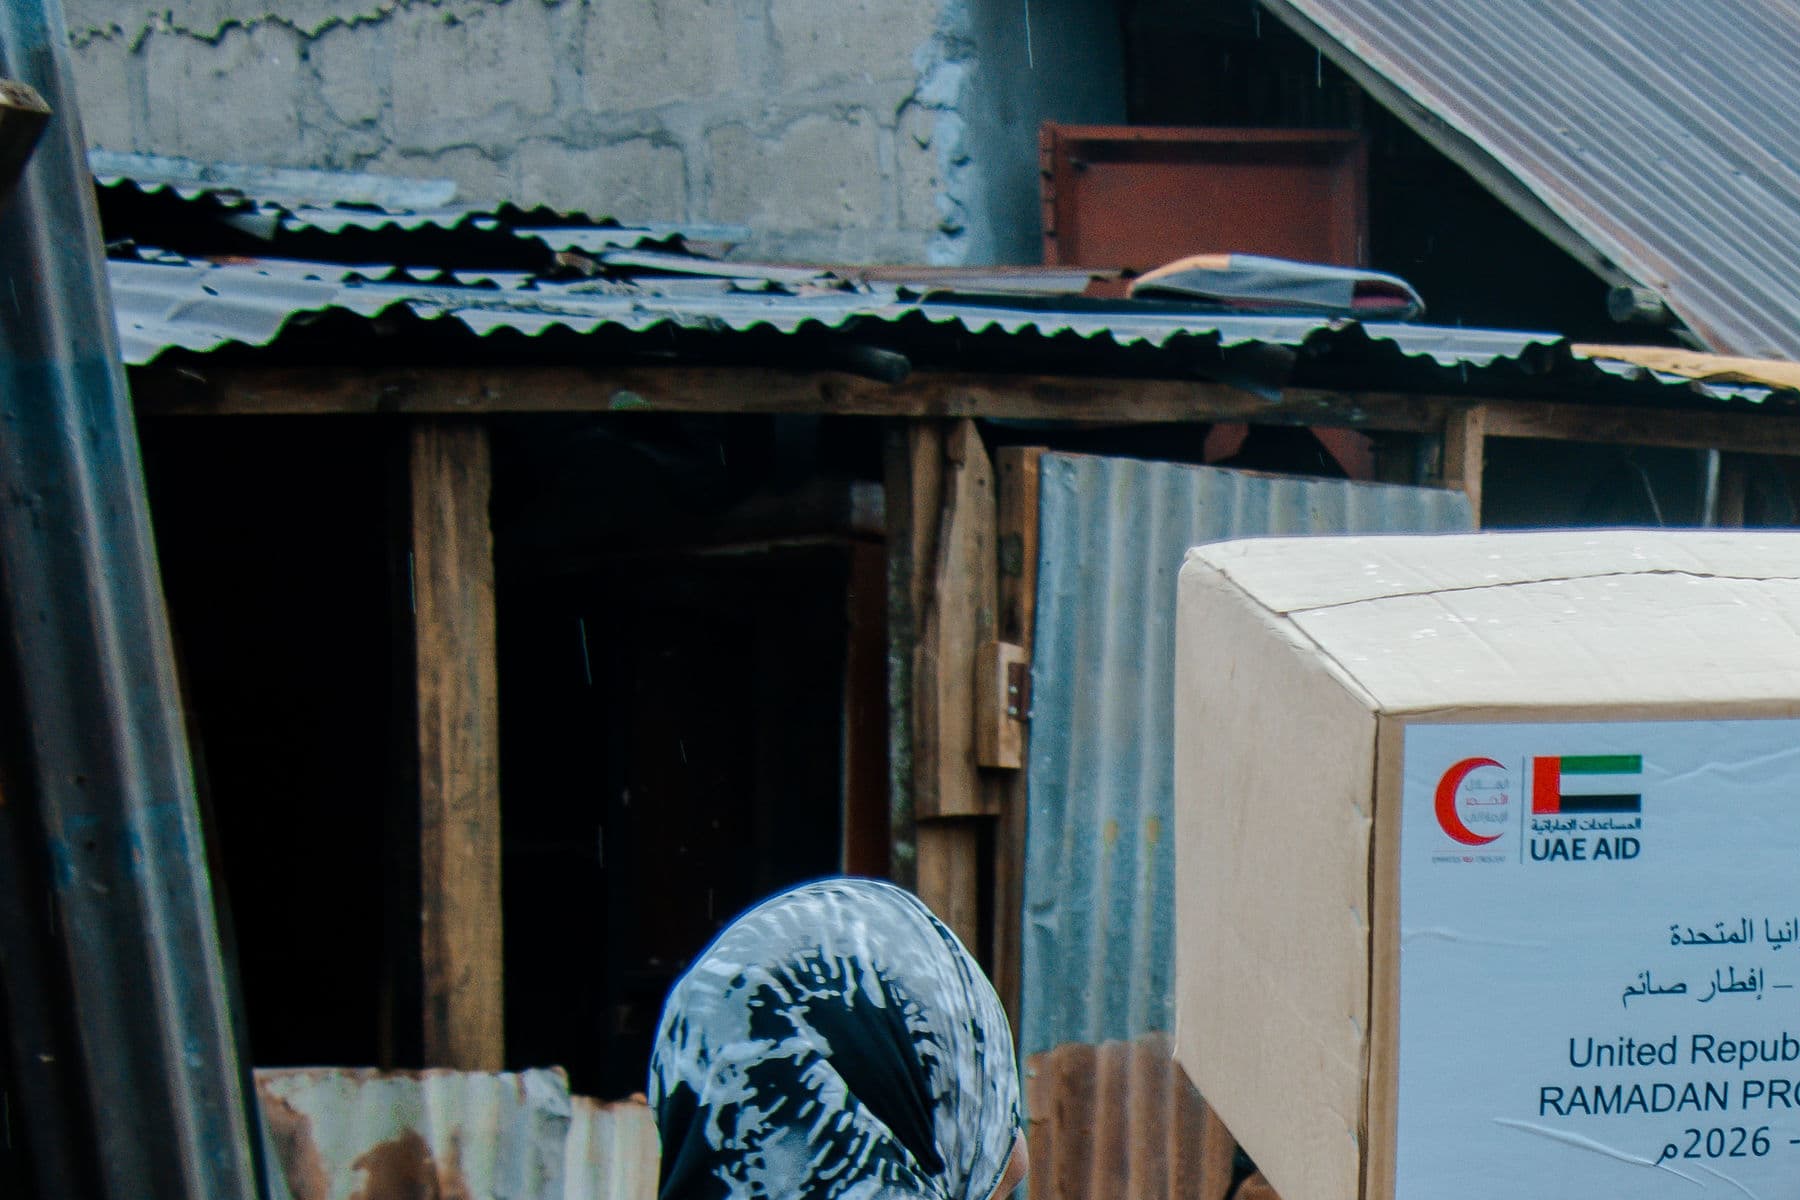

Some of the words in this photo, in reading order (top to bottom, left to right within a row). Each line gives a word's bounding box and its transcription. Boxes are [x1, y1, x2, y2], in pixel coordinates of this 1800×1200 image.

[1530, 838, 1588, 862] UAE
[1593, 836, 1641, 861] AID
[1670, 918, 1755, 946] المتحدة
[1622, 969, 1688, 1009] صائم
[1695, 966, 1764, 1003] إفطار
[1568, 1036, 1678, 1068] United
[1538, 1081, 1730, 1117] RAMADAN
